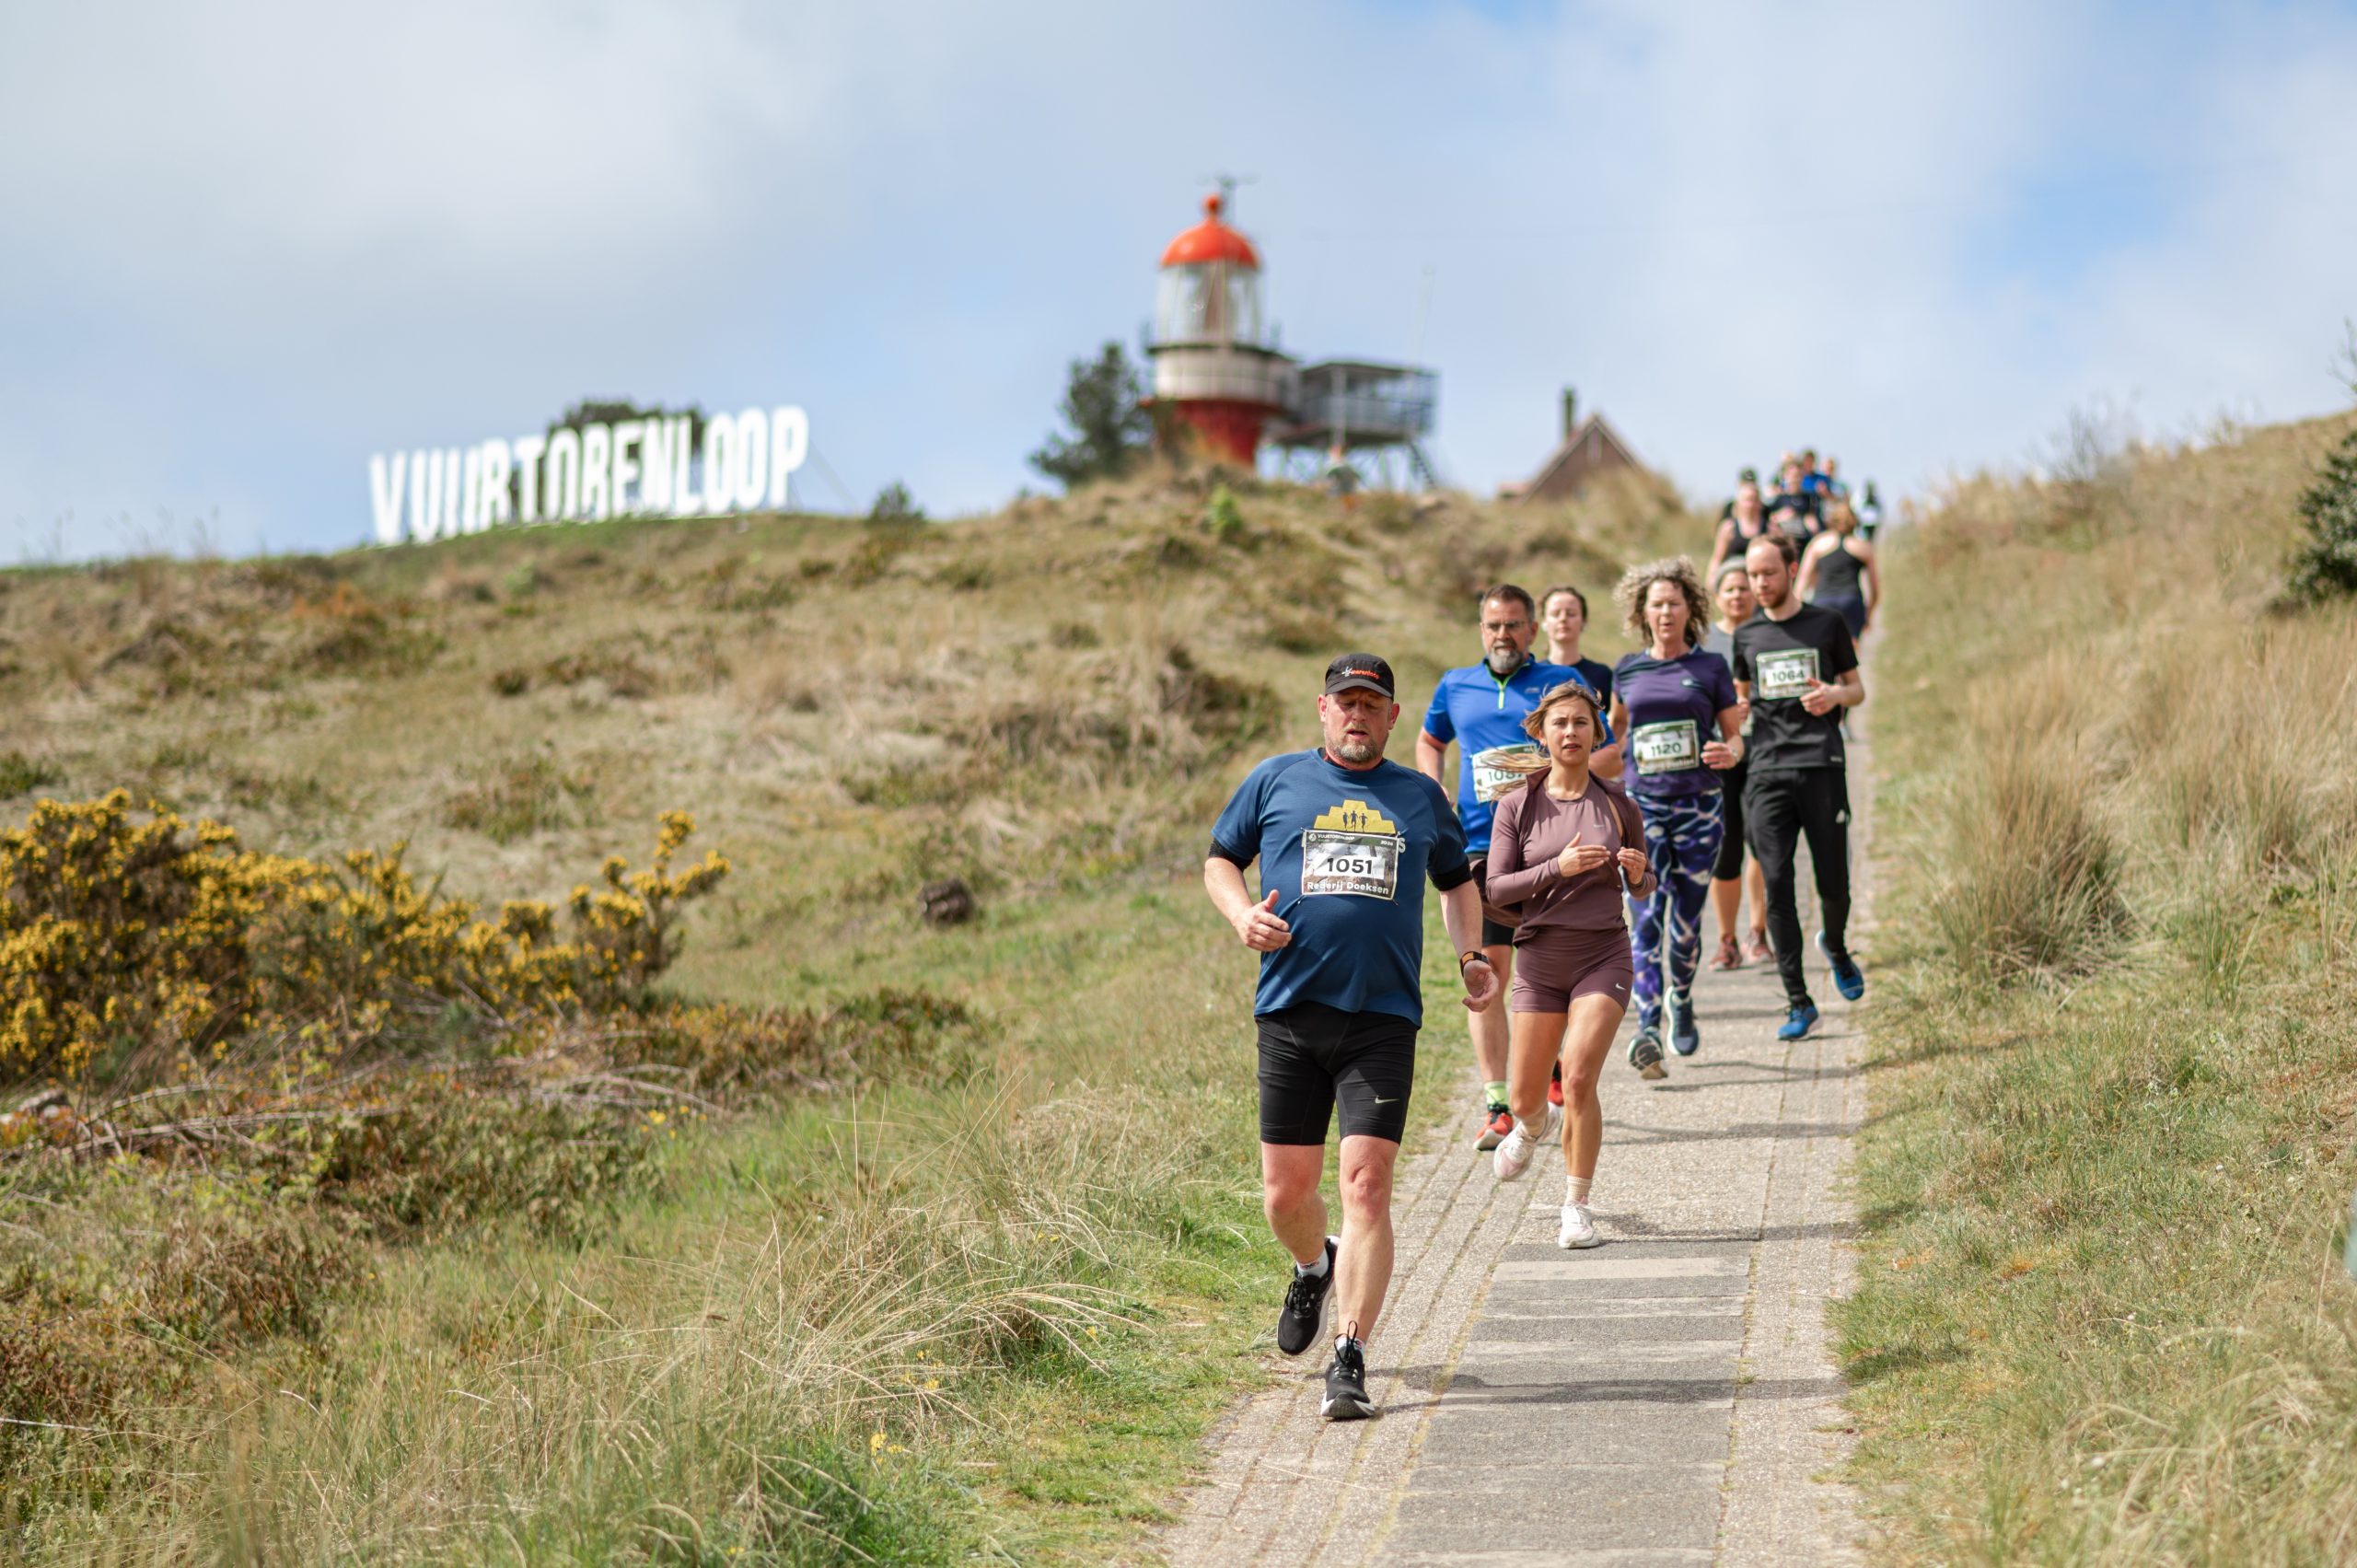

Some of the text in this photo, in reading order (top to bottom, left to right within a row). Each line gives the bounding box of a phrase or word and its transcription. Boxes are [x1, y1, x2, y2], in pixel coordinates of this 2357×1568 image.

[1771, 668, 1805, 683] 1064
[1651, 742, 1681, 757] 1120
[1327, 857, 1373, 875] 1051
[1307, 881, 1389, 895] Rederij Doeksen
